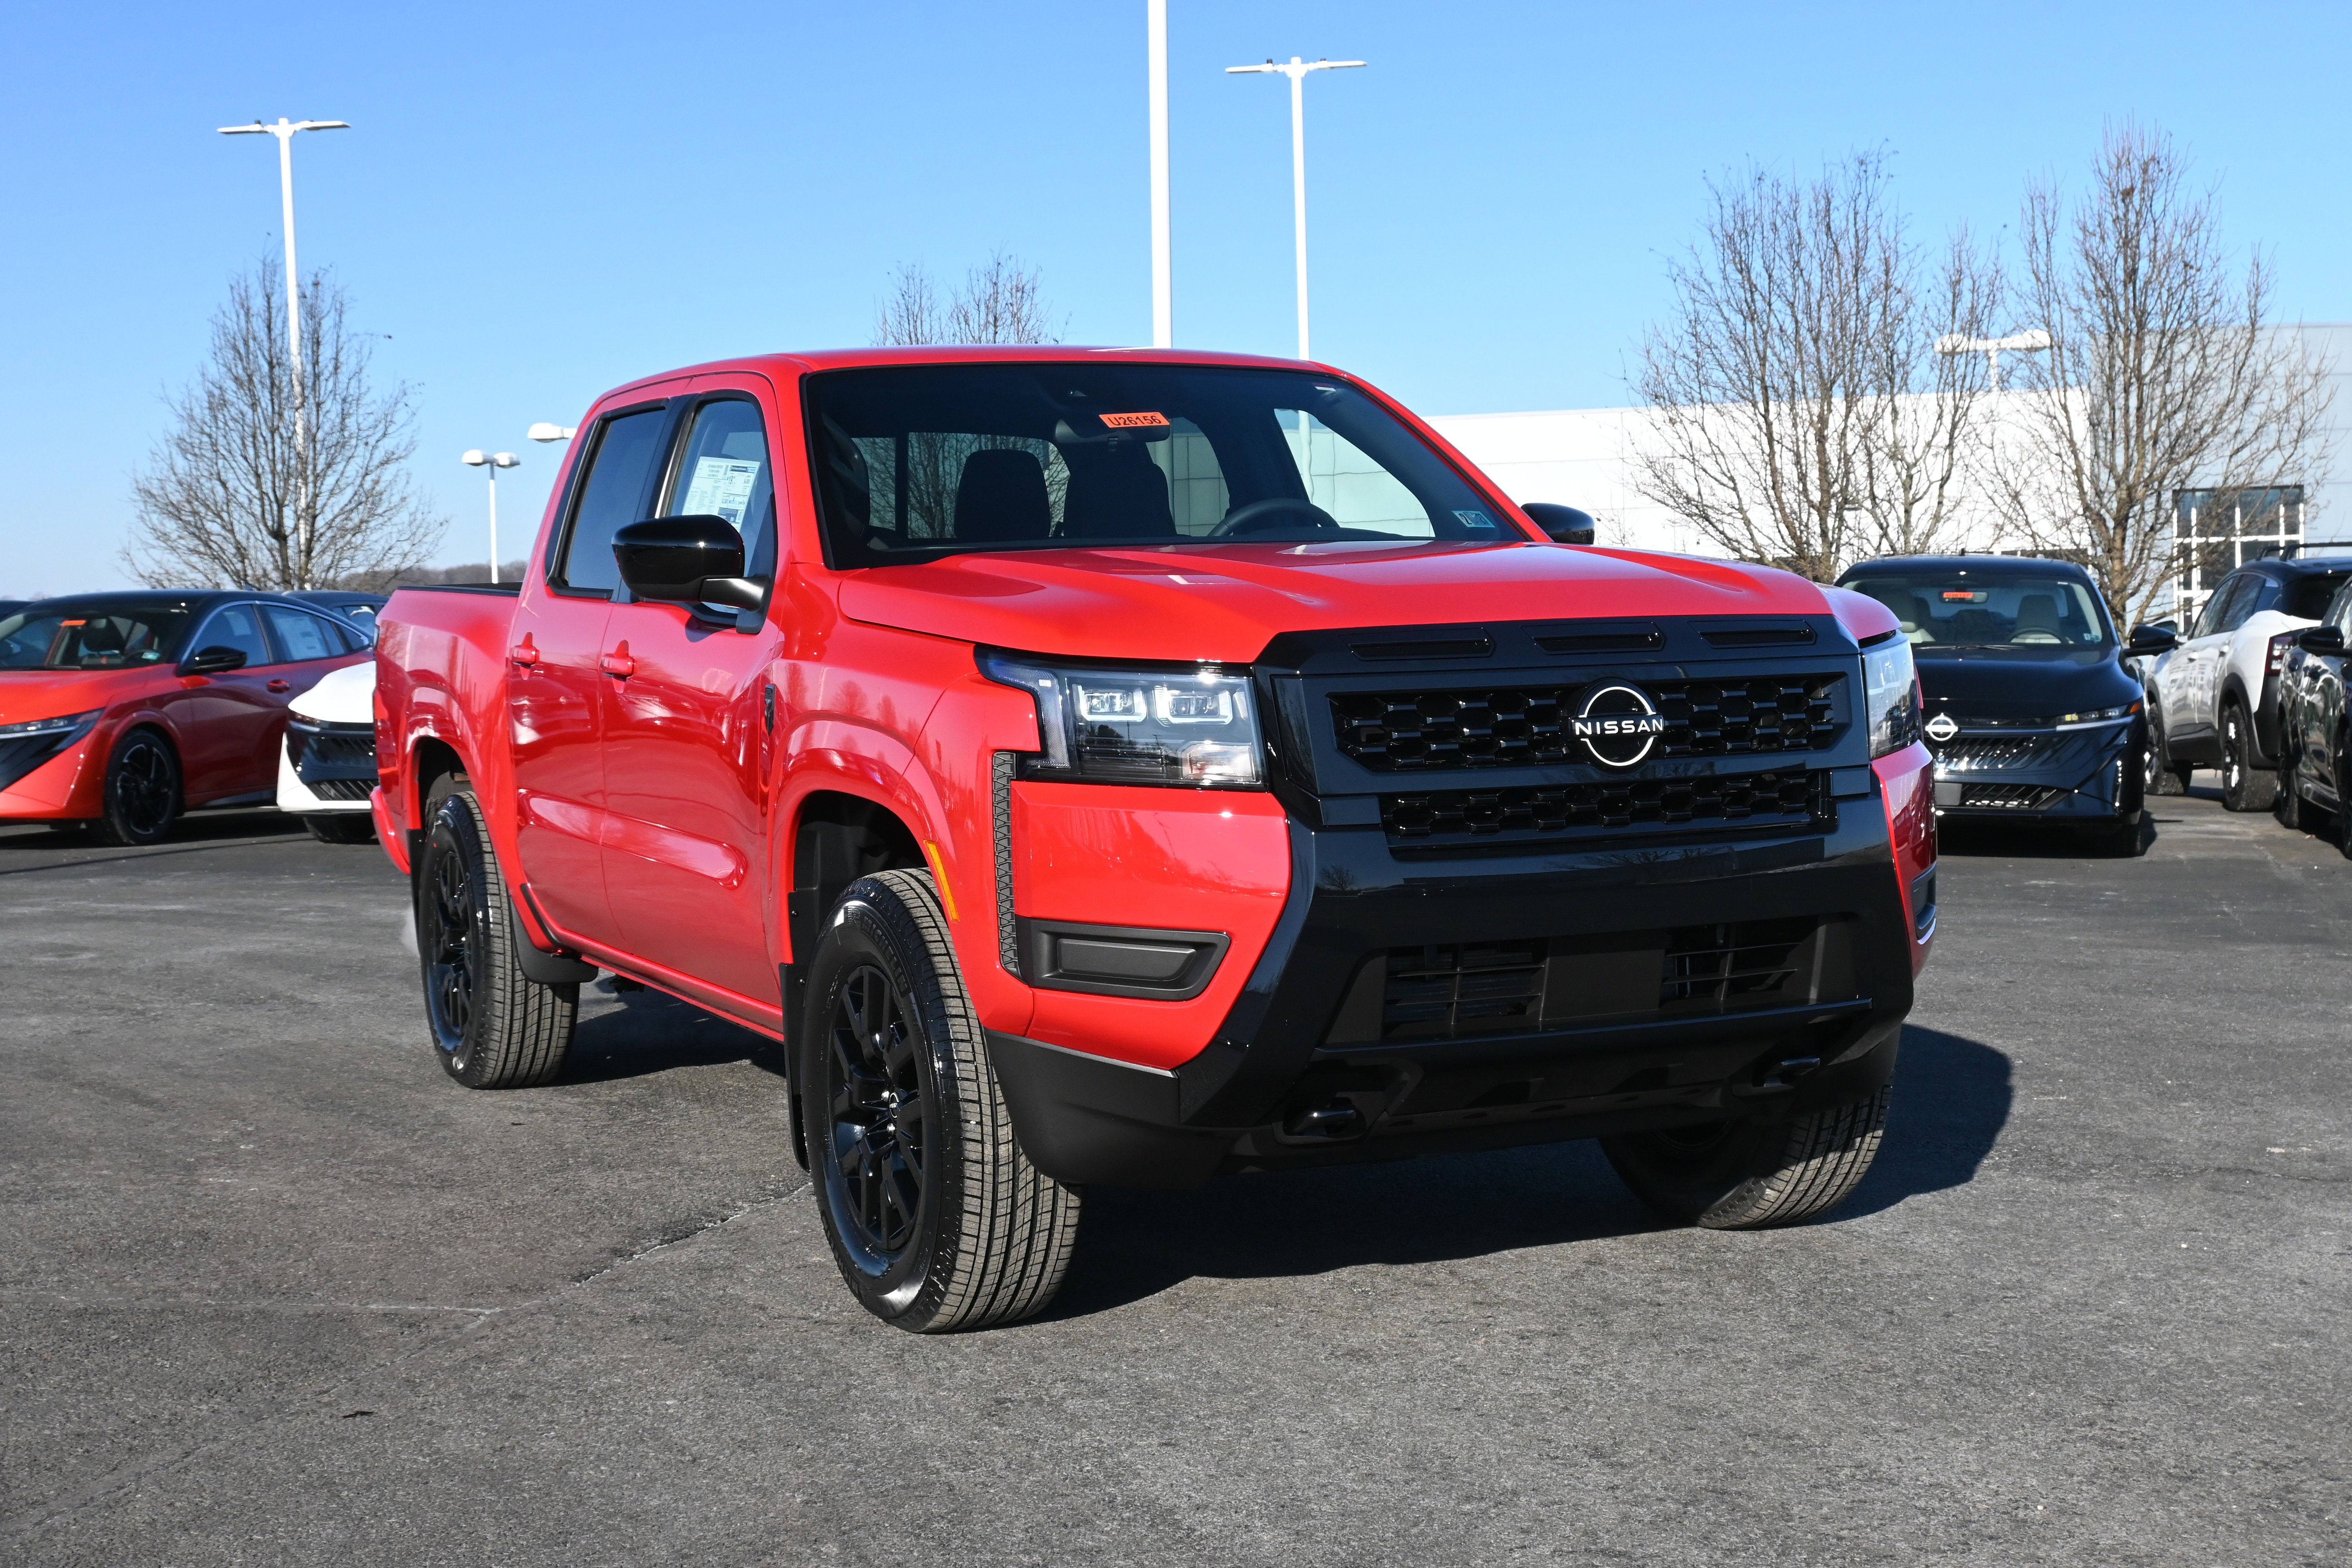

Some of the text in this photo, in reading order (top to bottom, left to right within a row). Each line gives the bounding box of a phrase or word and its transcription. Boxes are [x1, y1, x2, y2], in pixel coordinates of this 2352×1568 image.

[1107, 415, 1162, 426] U26156
[1575, 719, 1663, 735] NISSAN
[862, 915, 908, 993] MICHELIN
